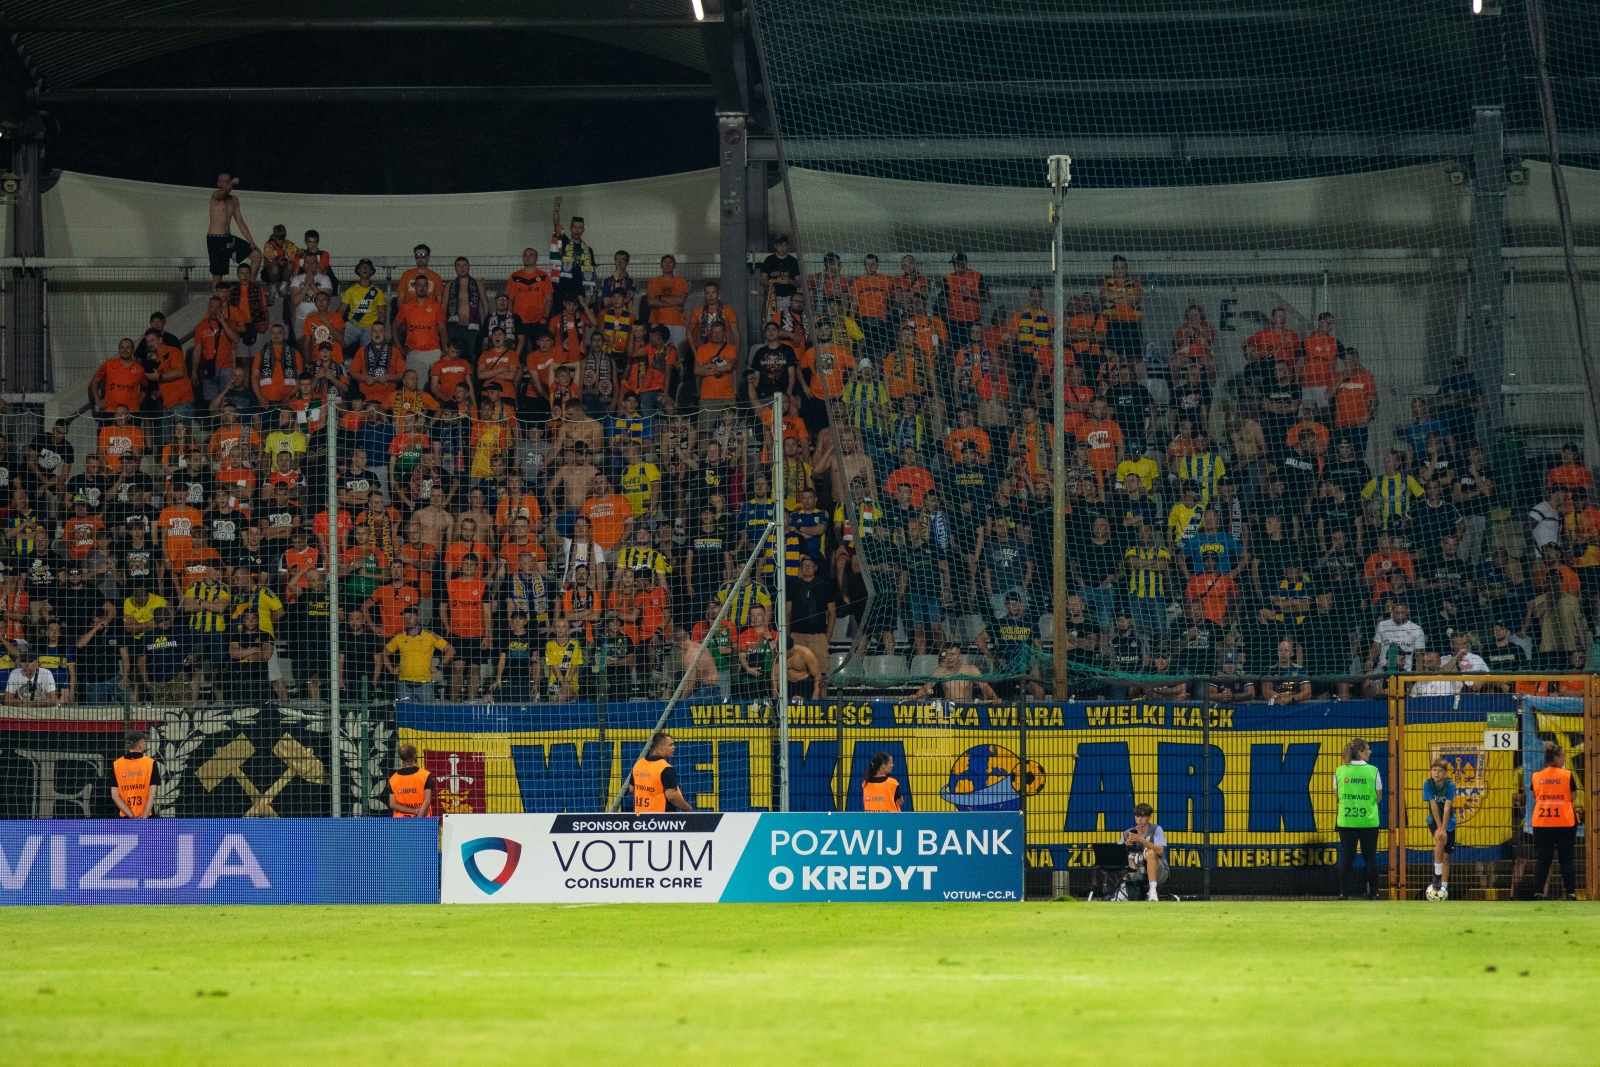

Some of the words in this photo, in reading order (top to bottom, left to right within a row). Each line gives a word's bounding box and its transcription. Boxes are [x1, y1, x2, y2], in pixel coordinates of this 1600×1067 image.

[1220, 299, 1237, 331] E
[690, 705, 776, 725] WIELKA
[787, 702, 873, 726] MIŁOŚĆ
[893, 705, 981, 726] WIELKA
[988, 707, 1064, 726] WIARA
[1086, 705, 1165, 726] WIELKI
[1492, 733, 1511, 748] 18
[1344, 807, 1367, 818] 239
[1539, 808, 1561, 817] 211
[572, 821, 630, 831] SPONSOR
[632, 818, 687, 831] GŁÓWNY
[771, 829, 903, 855] POZWIJ
[917, 829, 1013, 855] BANK
[552, 839, 713, 872] VOTUM
[1169, 848, 1200, 868] NA
[1215, 847, 1338, 868] NIEBIESKO
[565, 877, 655, 889] CONSUMER
[659, 877, 703, 888] CARE
[768, 865, 794, 891] O
[802, 865, 938, 891] KREDYT
[943, 890, 1017, 899] VOTUM-CC.PL
